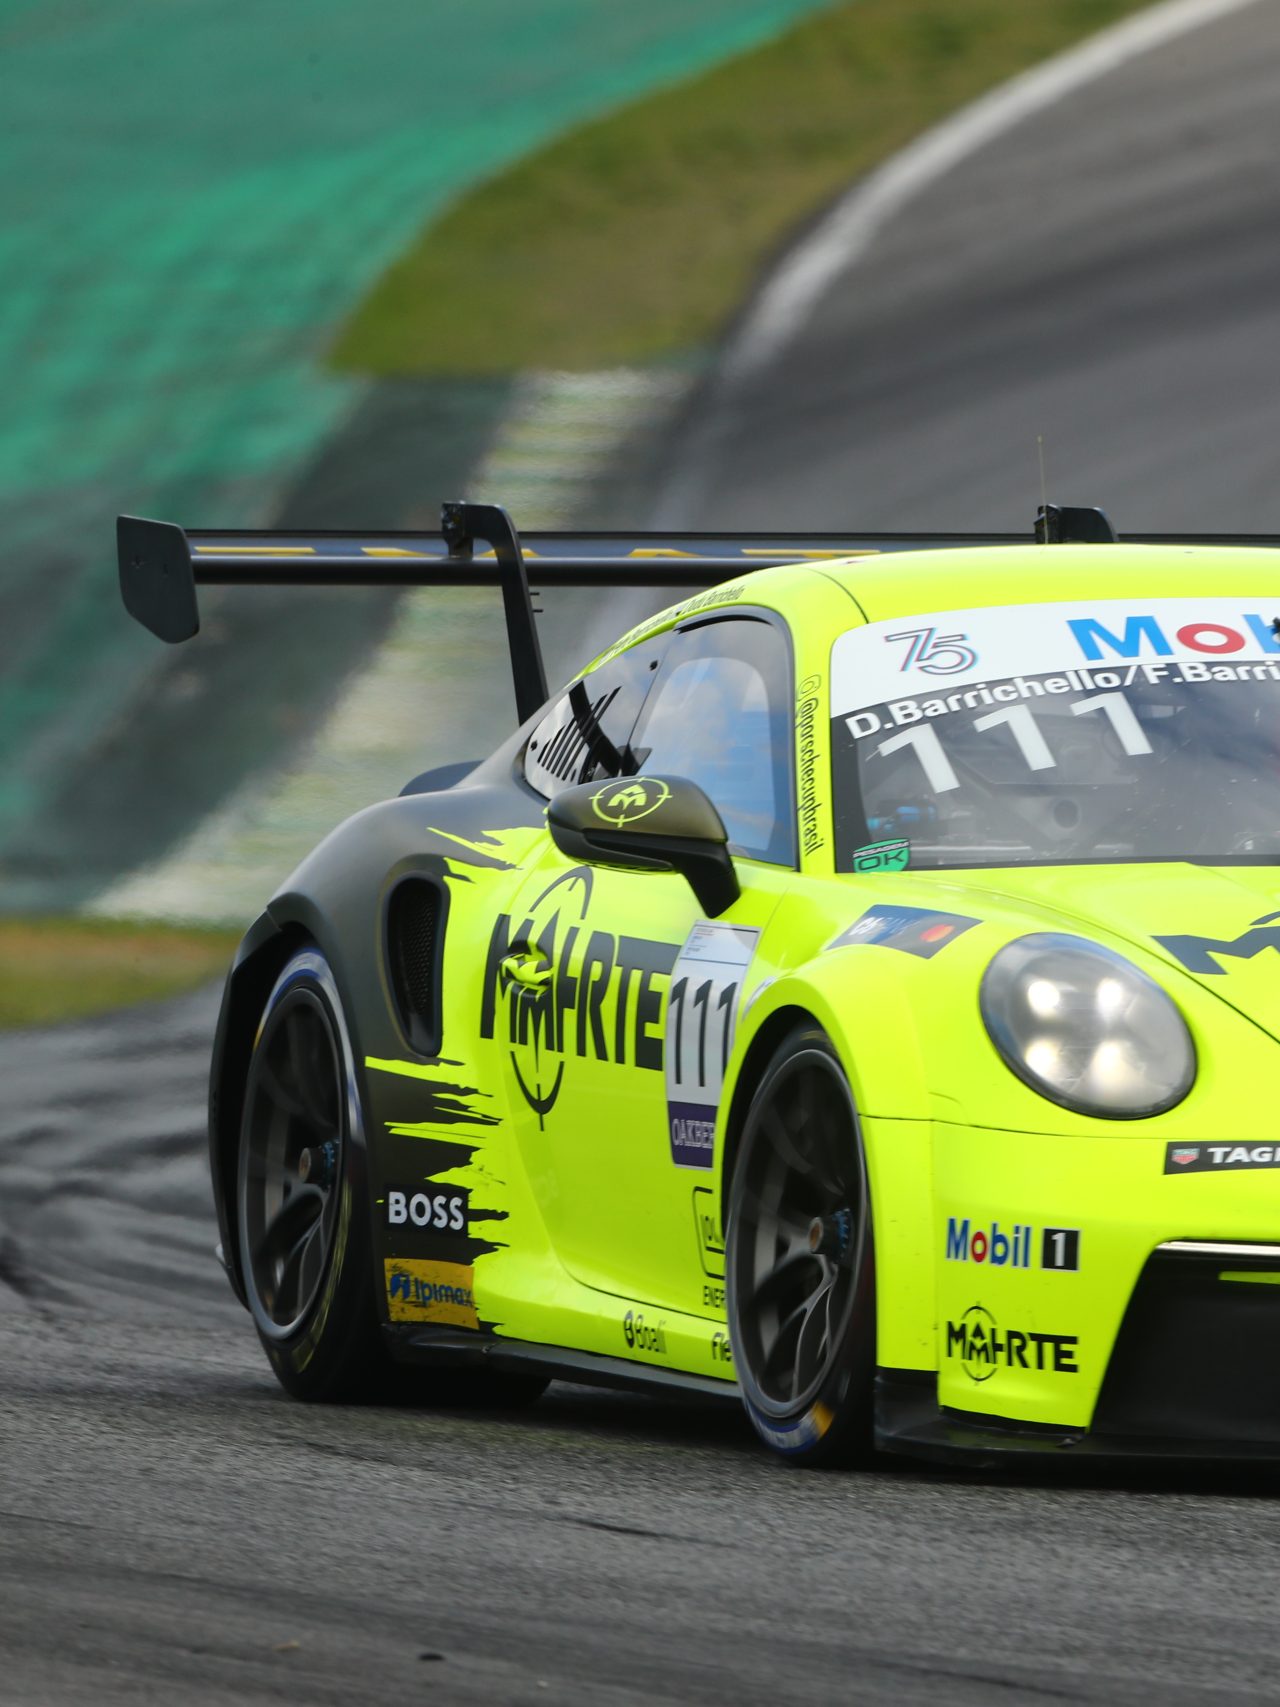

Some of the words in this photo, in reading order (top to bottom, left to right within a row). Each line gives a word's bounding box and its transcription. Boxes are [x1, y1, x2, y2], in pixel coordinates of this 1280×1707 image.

[884, 627, 977, 676] 75
[876, 691, 1154, 794] 111
[858, 850, 905, 871] OK
[669, 976, 738, 1088] 111
[388, 1191, 464, 1231] BOSS
[946, 1217, 1031, 1268] Mobil
